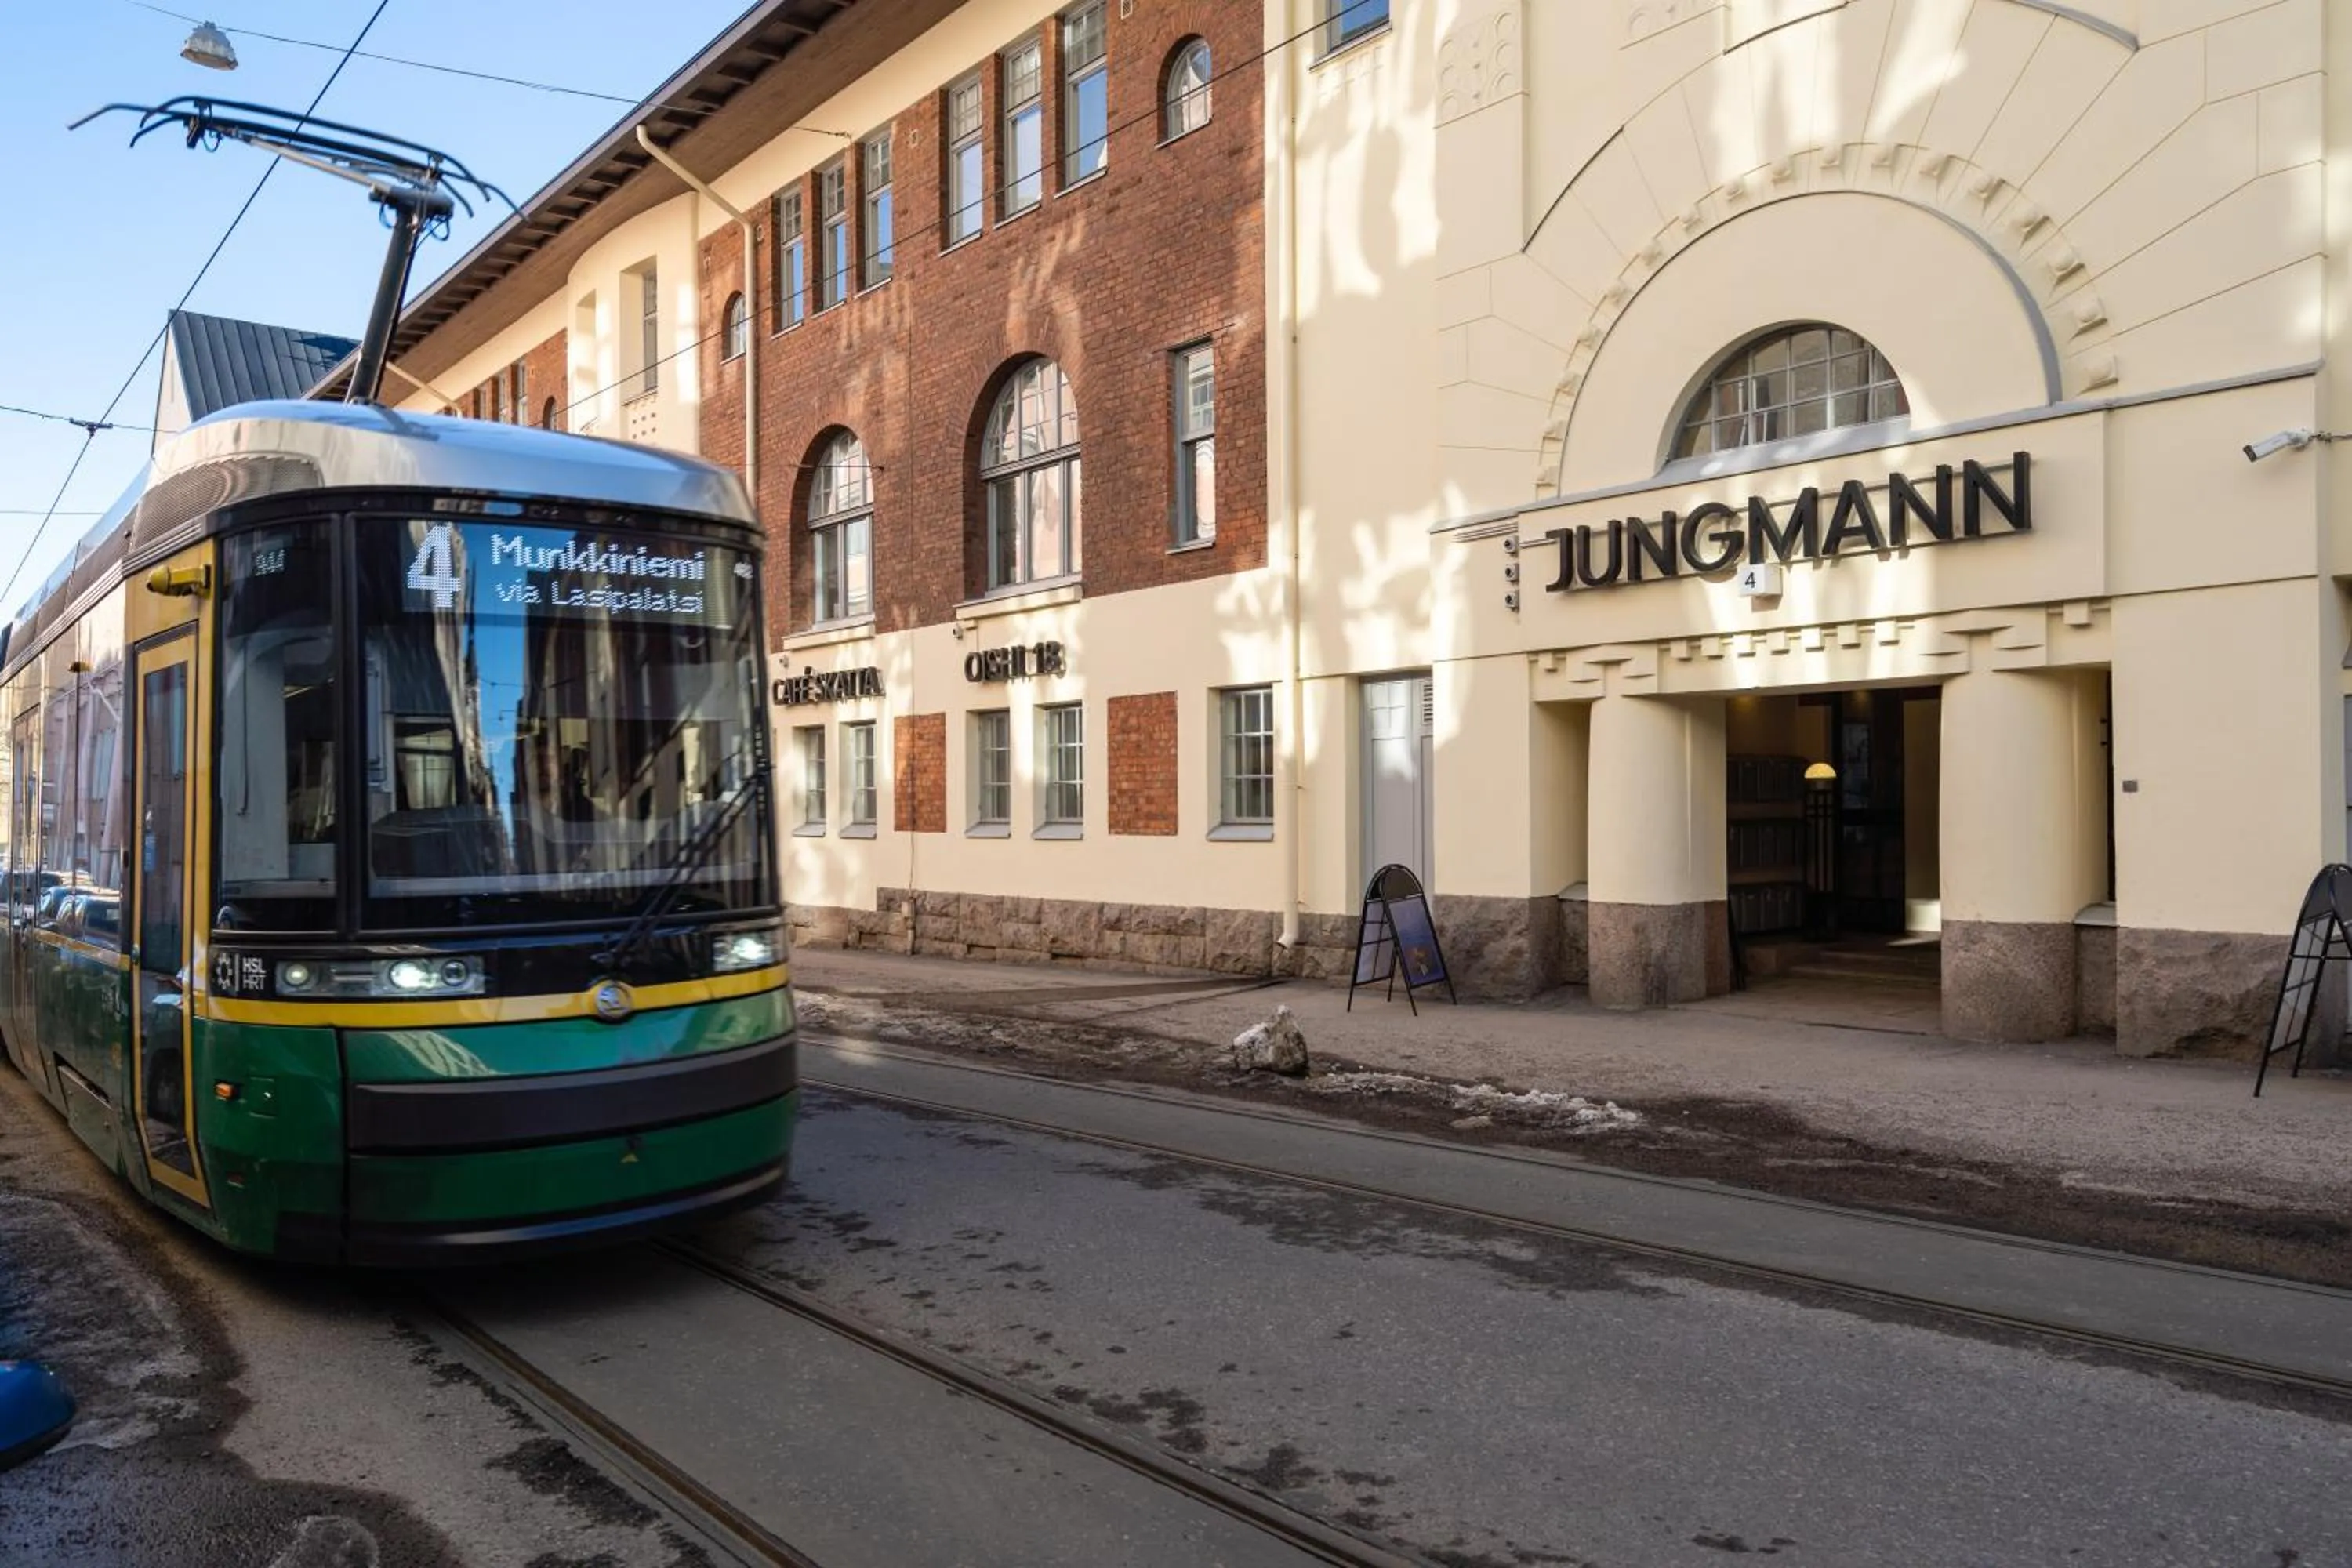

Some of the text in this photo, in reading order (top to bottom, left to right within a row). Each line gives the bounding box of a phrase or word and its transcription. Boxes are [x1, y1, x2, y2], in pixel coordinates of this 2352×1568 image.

[1546, 451, 2031, 592] JUNGMANN
[407, 524, 461, 608] 4
[491, 534, 705, 579] Munkkiniemi
[495, 579, 703, 614] via Lasipalatsi
[1744, 572, 1756, 589] 4
[964, 644, 1026, 683] OISHI
[772, 666, 881, 705] CAFÉ SKATTA
[242, 957, 267, 974] HSL
[242, 974, 267, 990] HRT
